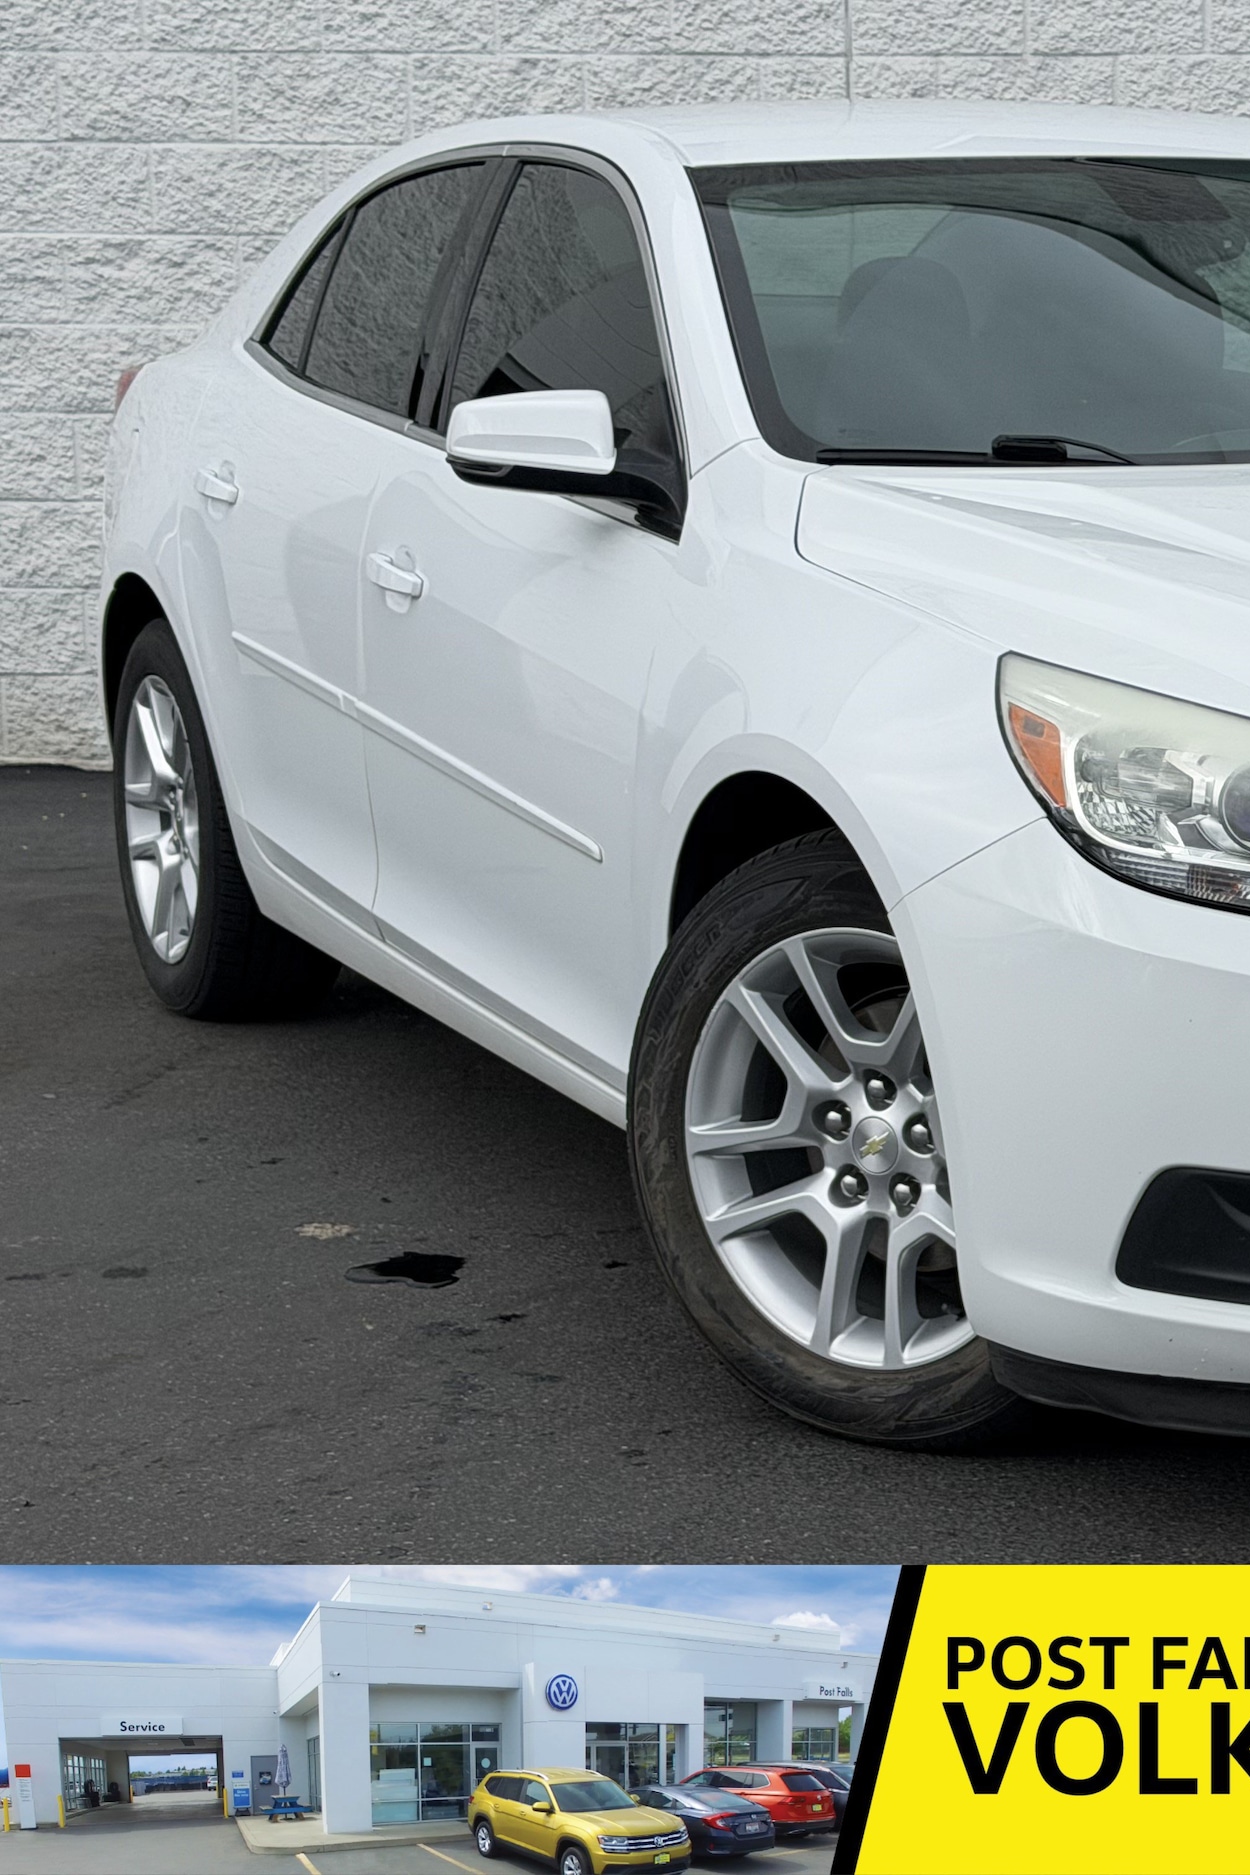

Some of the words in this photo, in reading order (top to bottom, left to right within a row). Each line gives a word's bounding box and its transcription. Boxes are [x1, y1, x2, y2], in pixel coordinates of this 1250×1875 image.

[550, 1676, 577, 1708] VW
[819, 1685, 835, 1697] Post
[836, 1686, 853, 1697] Falls
[120, 1720, 165, 1732] Service
